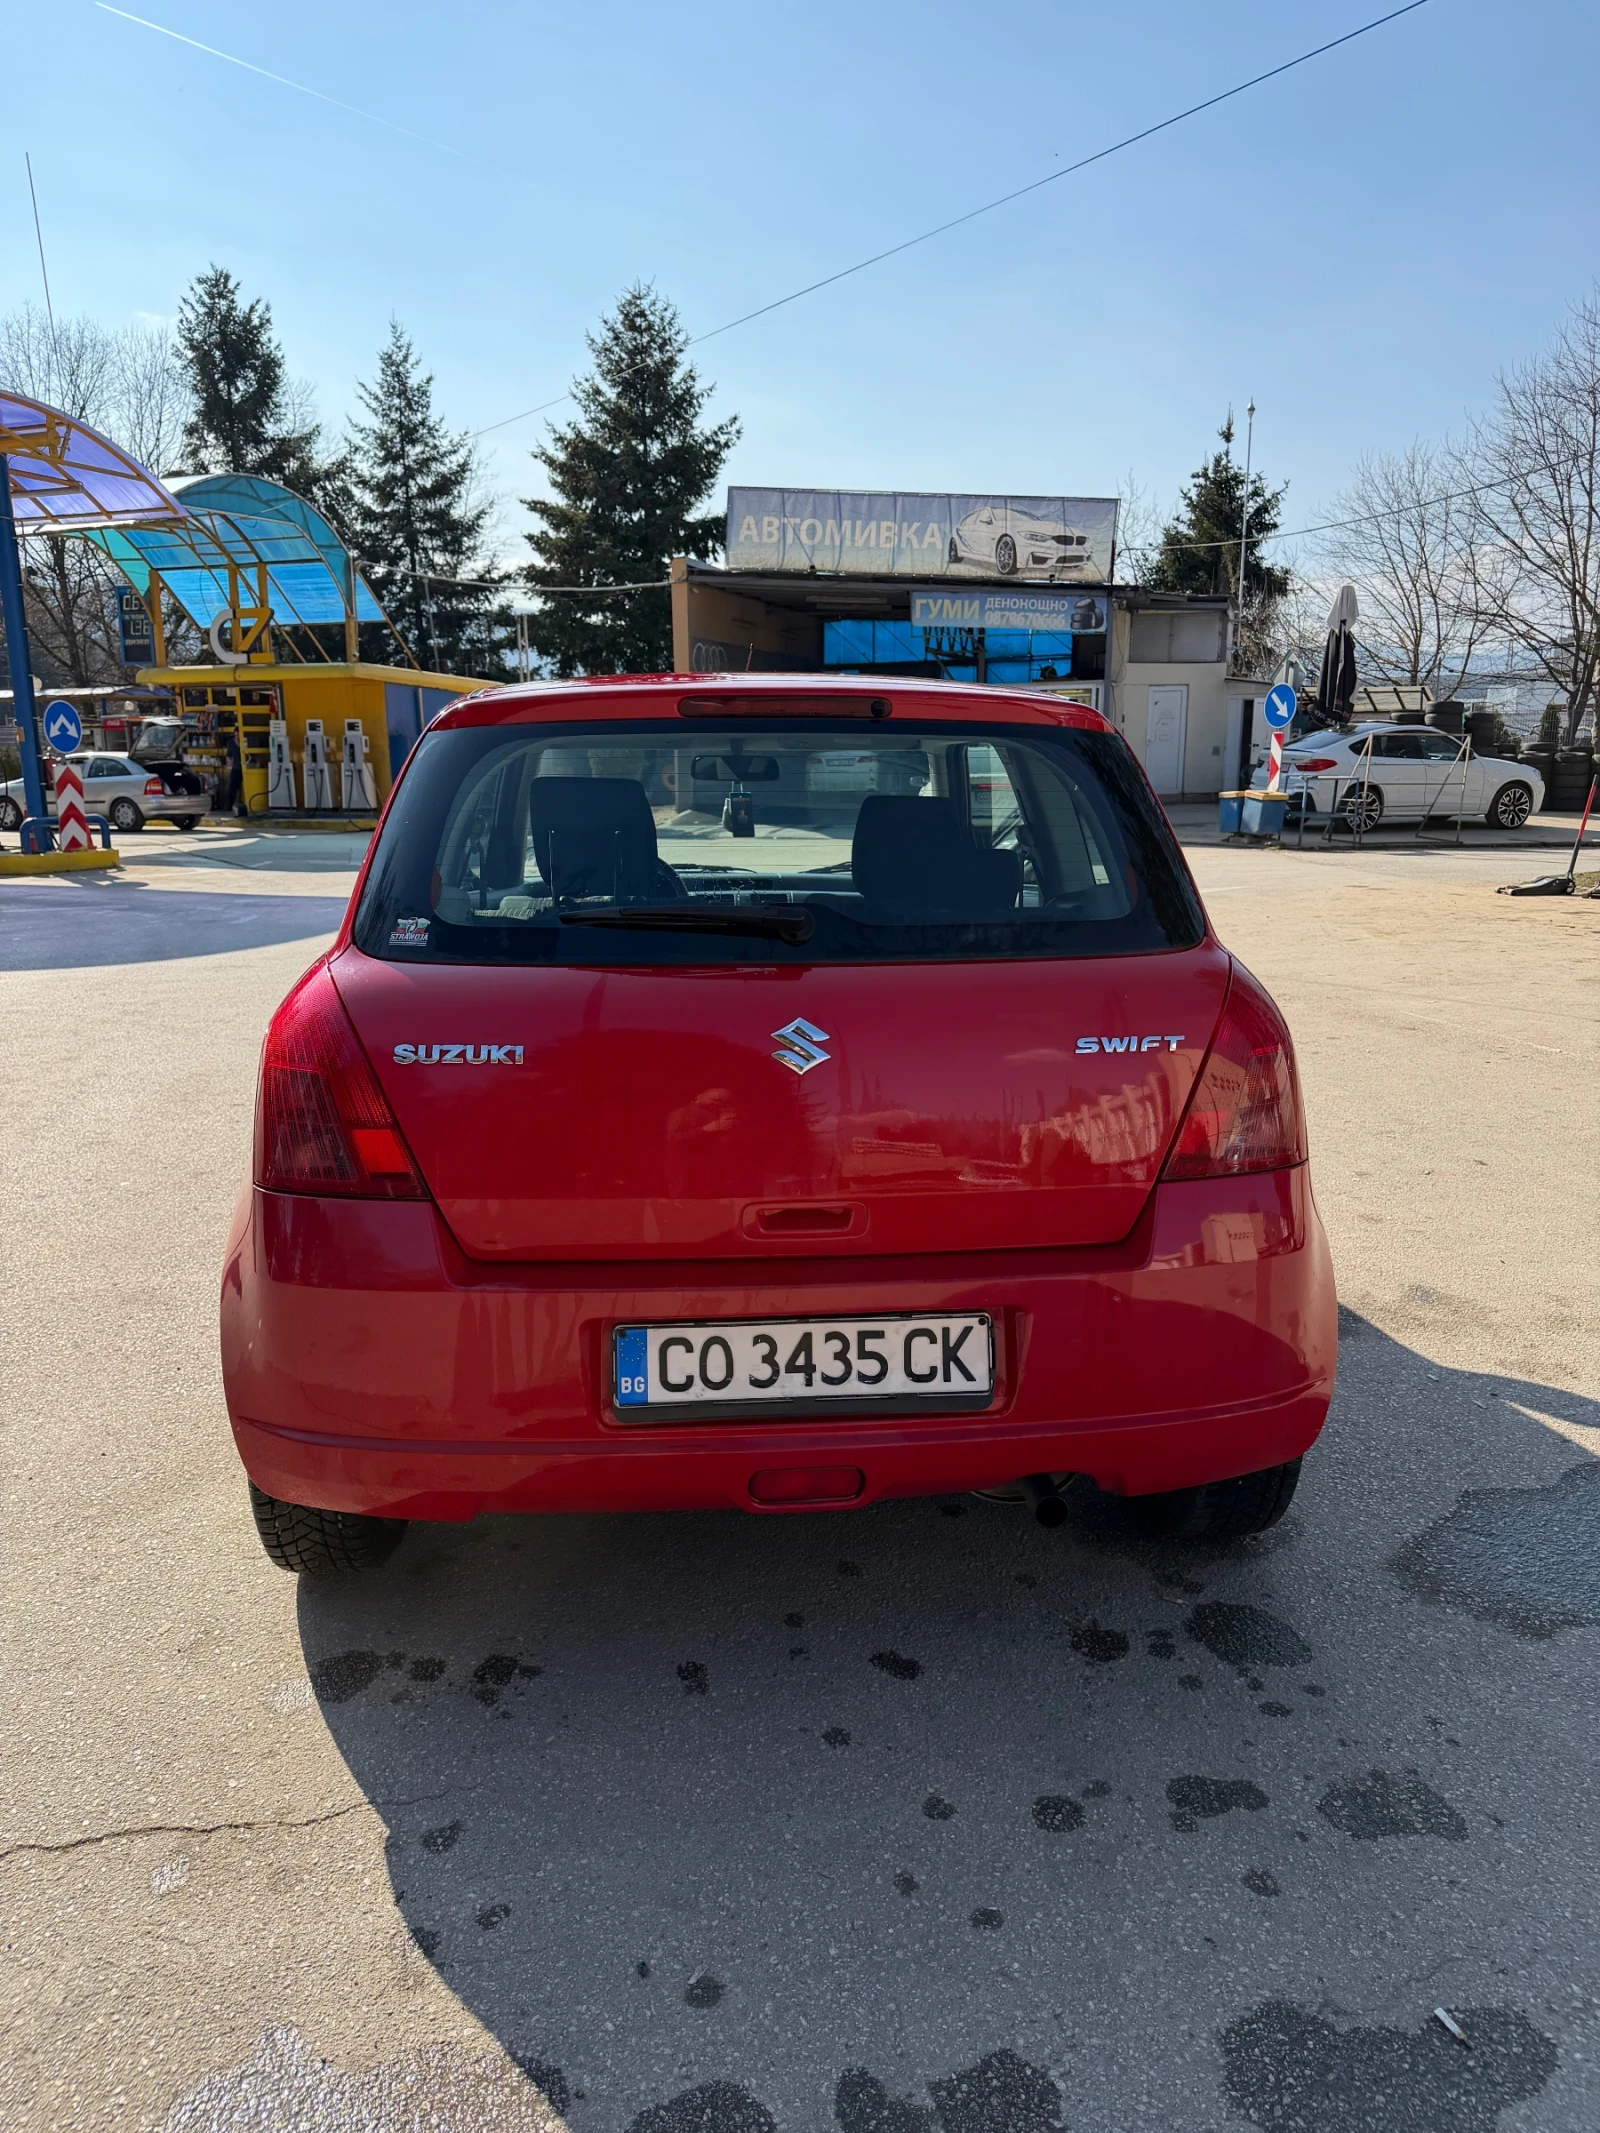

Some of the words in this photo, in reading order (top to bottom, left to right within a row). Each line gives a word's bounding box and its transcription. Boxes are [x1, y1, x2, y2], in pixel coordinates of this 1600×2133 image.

[738, 515, 943, 551] АВТОМИВКА
[914, 598, 980, 620] ГУМИ
[985, 597, 1068, 612] ДЕНОНОЩНО
[393, 1043, 525, 1065] SUZUKI
[1075, 1035, 1185, 1054] SWIFT
[658, 1335, 734, 1393] CO
[748, 1330, 890, 1389] 3435
[903, 1326, 977, 1383] CK
[620, 1376, 645, 1395] BG
